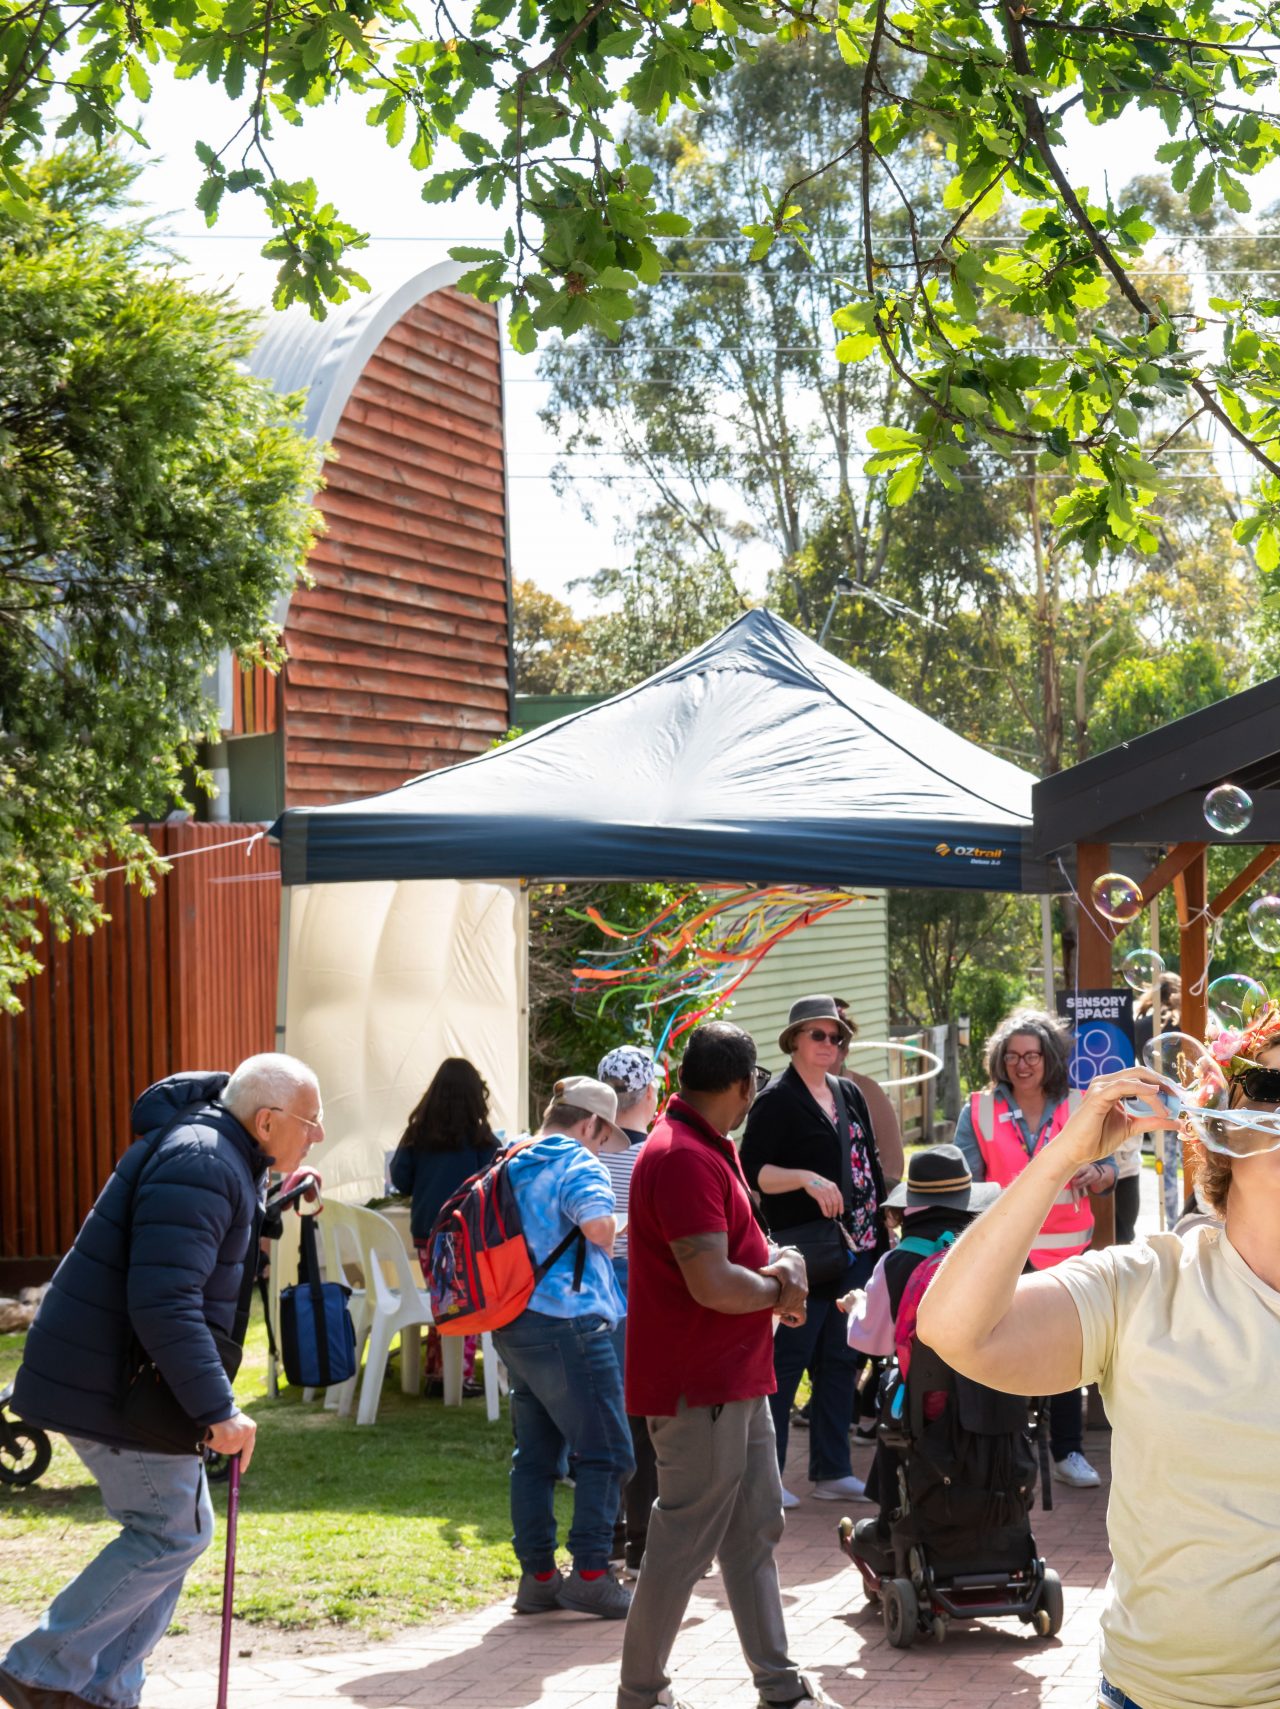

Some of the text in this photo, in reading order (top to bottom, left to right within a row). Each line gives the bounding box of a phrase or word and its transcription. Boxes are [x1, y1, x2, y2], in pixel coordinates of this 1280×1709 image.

[954, 846, 1002, 858] OZtrail
[1066, 996, 1127, 1008] SENSORY
[1077, 1007, 1119, 1019] SPACE
